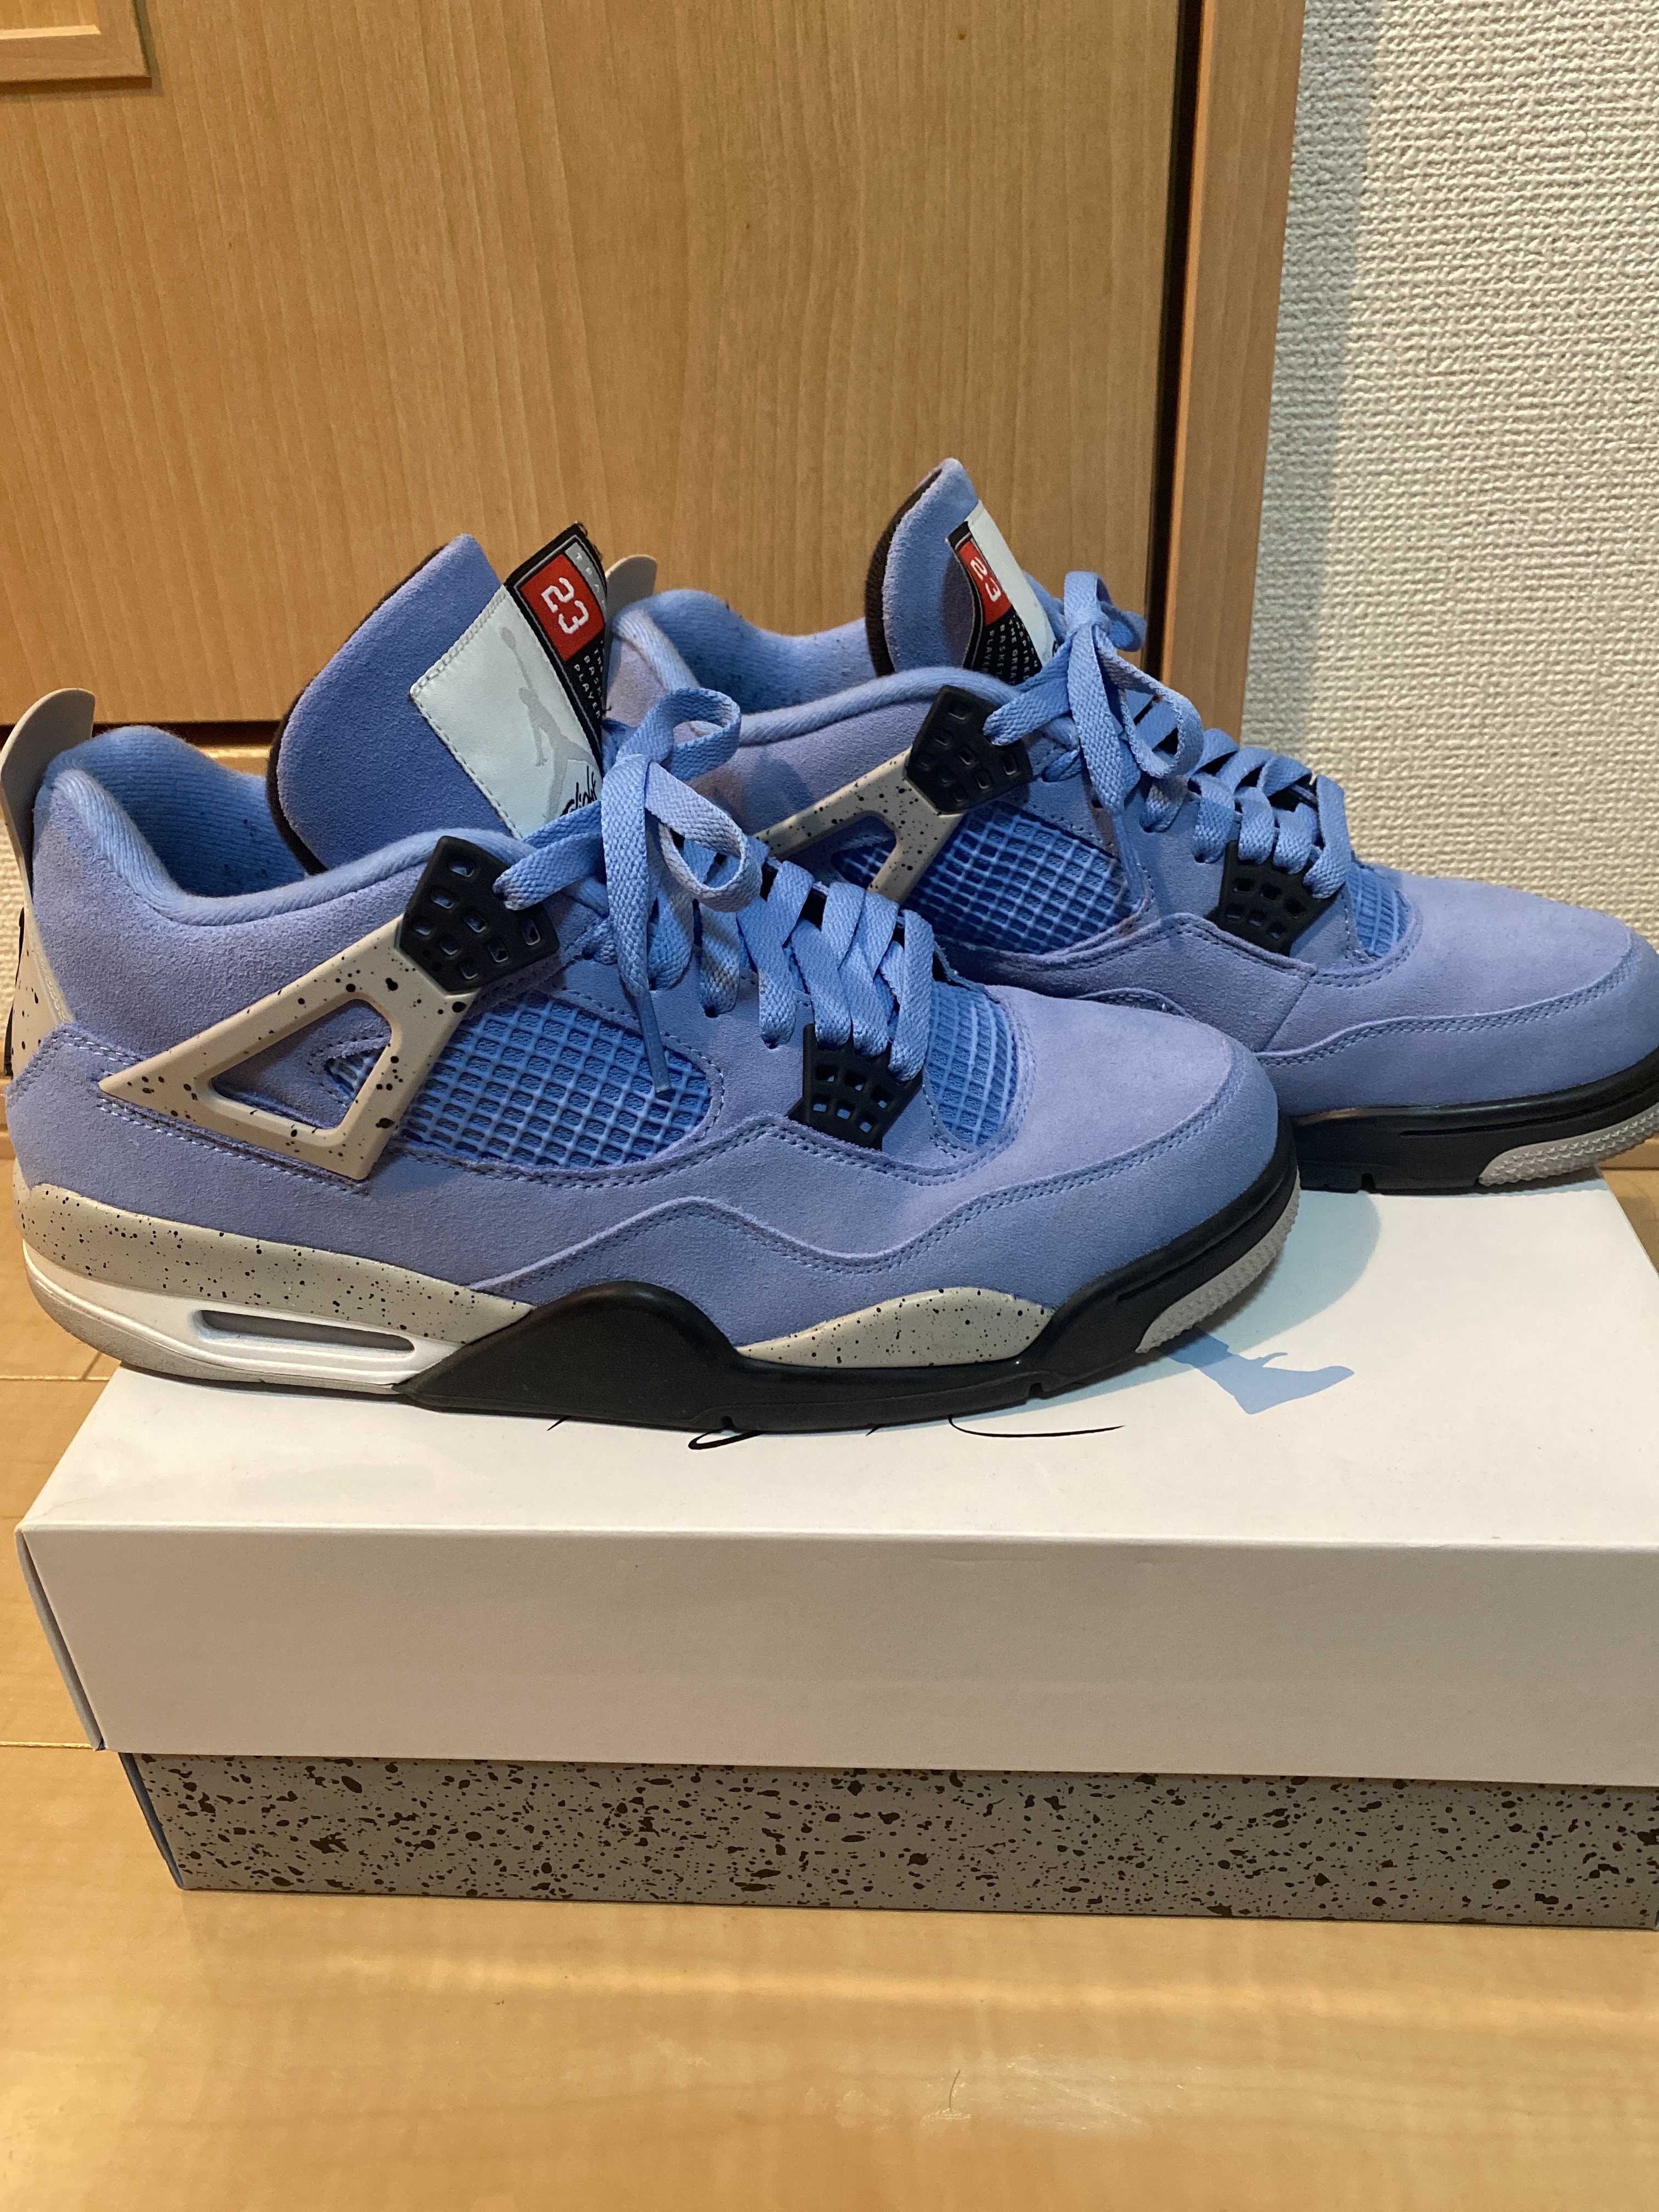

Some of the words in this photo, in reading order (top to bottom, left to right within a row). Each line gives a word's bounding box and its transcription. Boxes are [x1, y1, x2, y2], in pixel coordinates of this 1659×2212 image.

[970, 556, 1001, 602] 23
[540, 577, 589, 634] 23
[996, 624, 1006, 675] BASKET
[1009, 649, 1018, 684] GREAT
[573, 664, 601, 719] PLAYER
[584, 655, 602, 697] BASK
